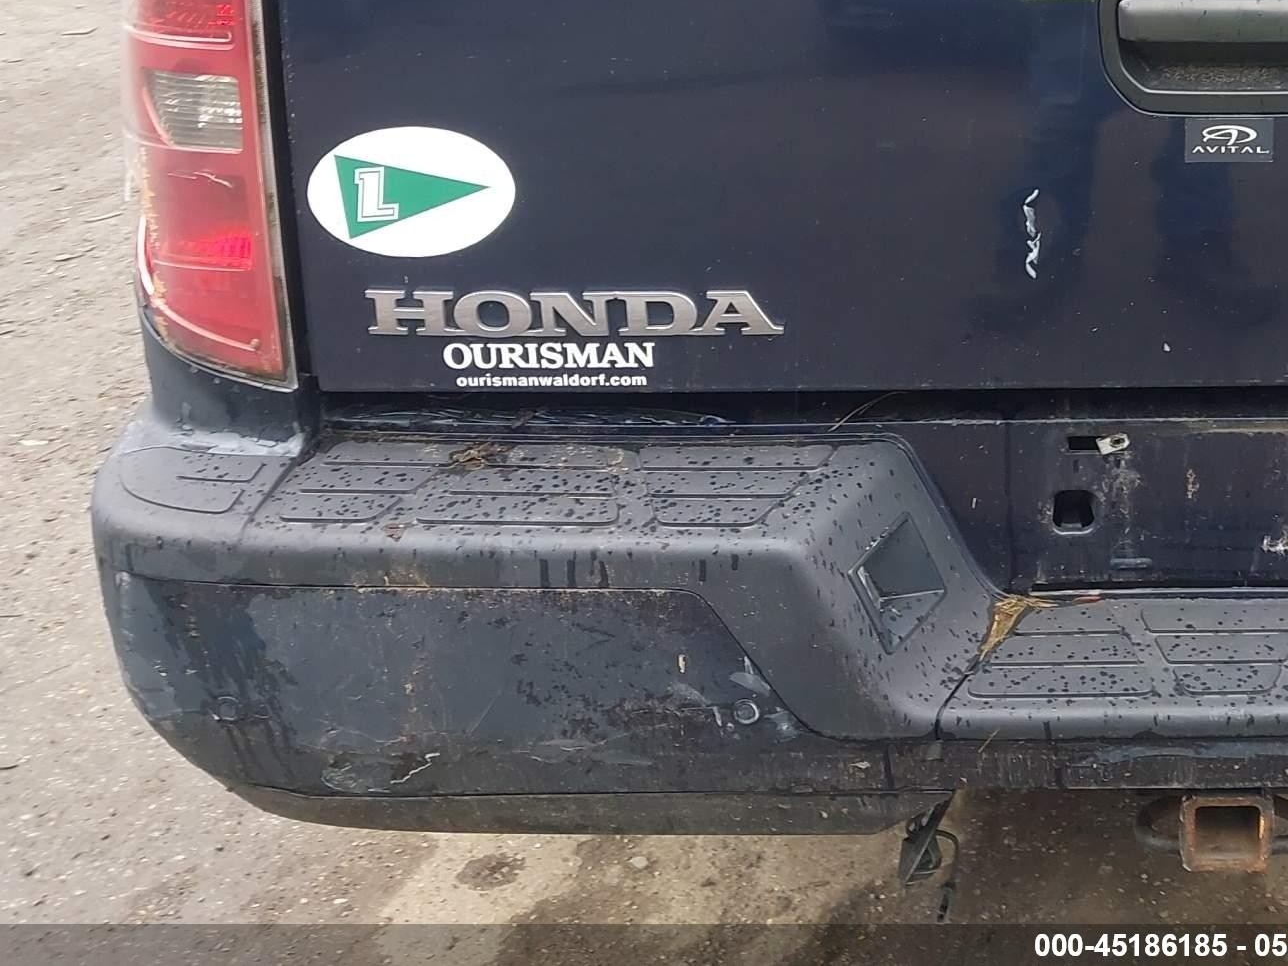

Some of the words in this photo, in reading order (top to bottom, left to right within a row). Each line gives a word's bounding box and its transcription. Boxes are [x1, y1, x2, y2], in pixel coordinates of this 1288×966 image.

[1191, 145, 1271, 155] AVITAL
[354, 167, 400, 223] L
[365, 290, 784, 337] HONDA
[443, 342, 656, 370] OURISMAN
[456, 374, 648, 389] ourismanwaldorf.com
